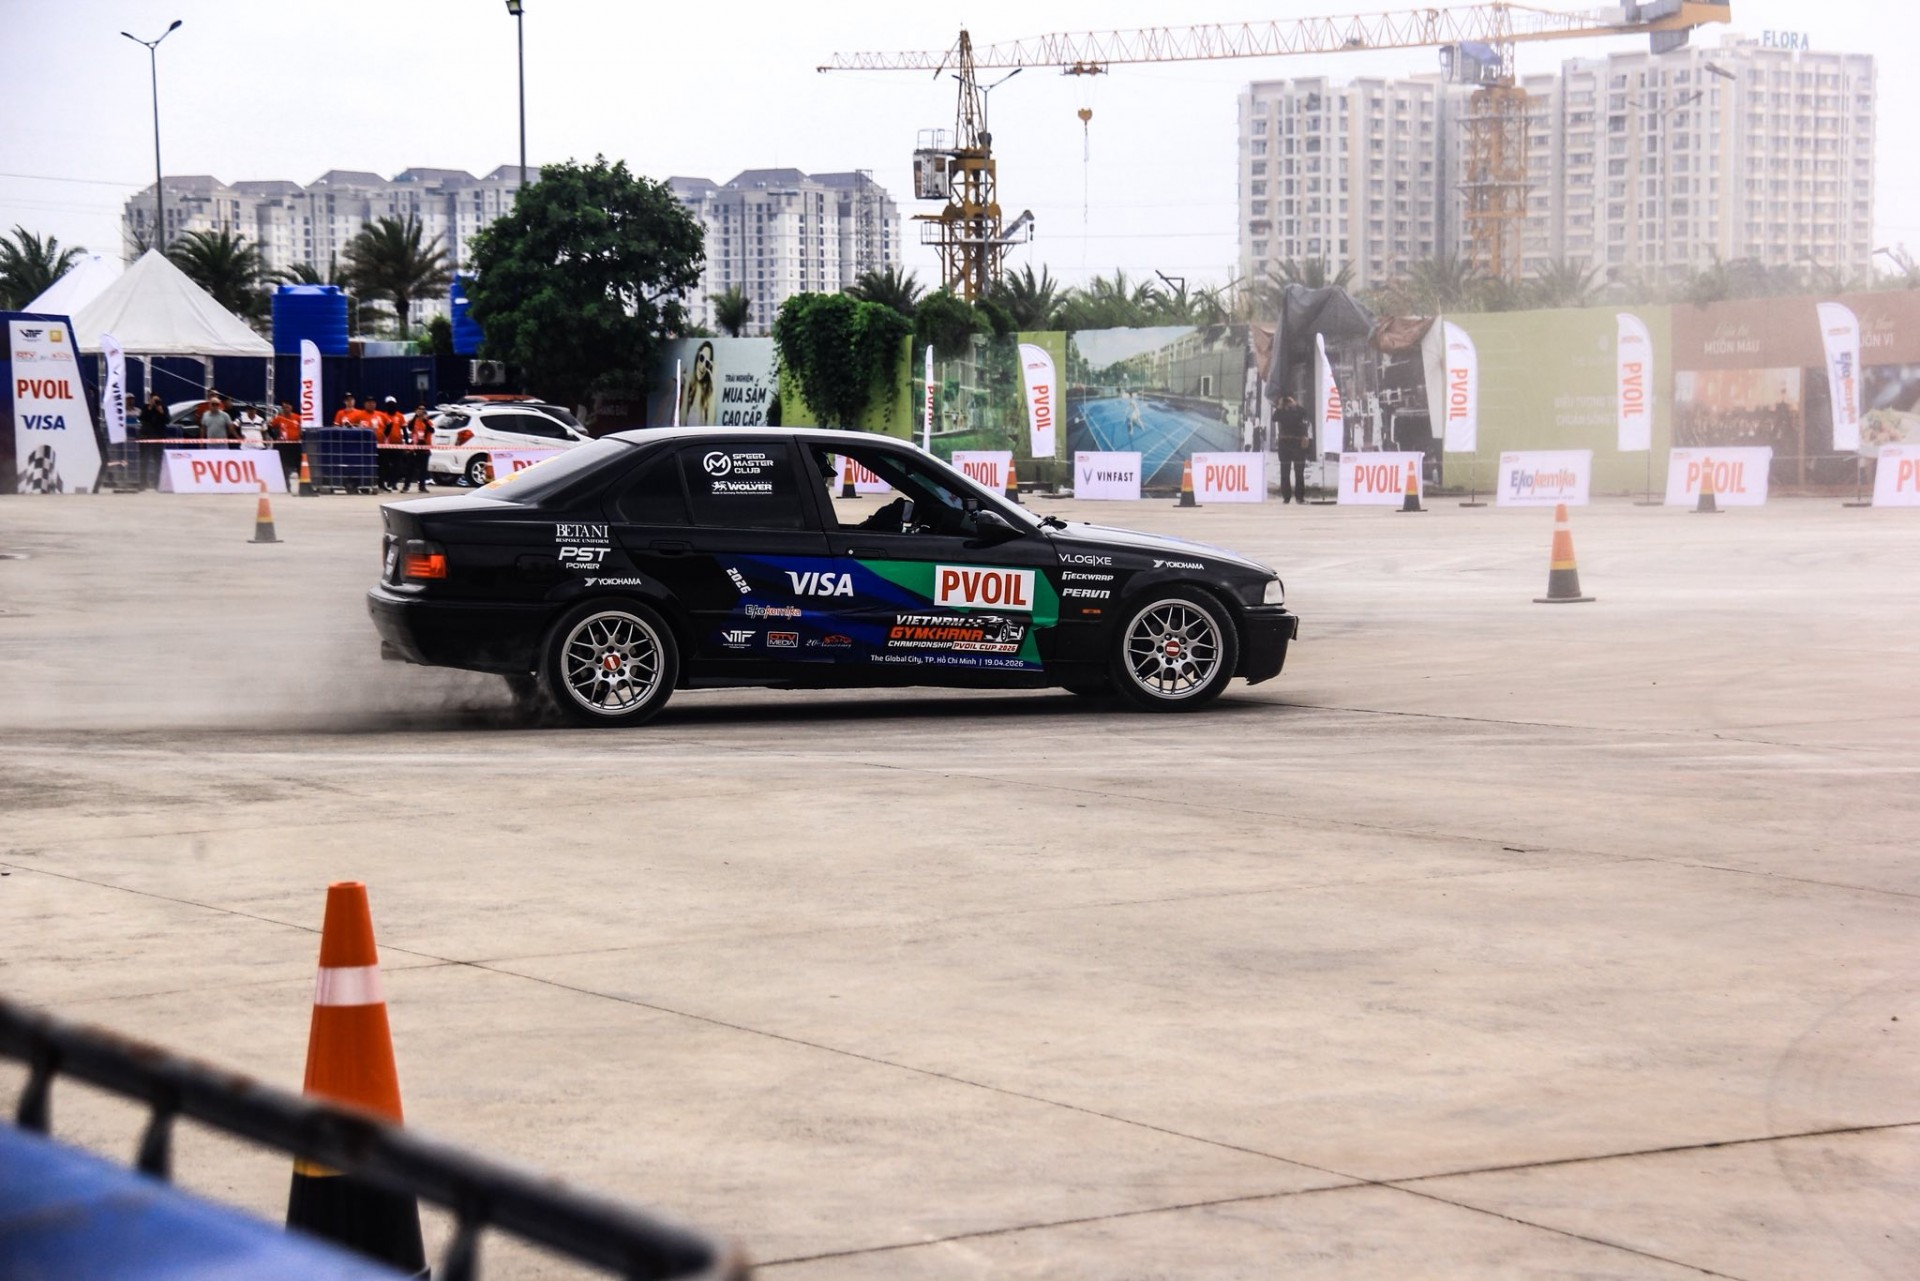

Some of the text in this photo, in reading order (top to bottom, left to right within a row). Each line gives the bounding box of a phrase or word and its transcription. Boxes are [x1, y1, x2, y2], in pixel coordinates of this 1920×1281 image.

[1763, 30, 1809, 51] FLORA
[17, 380, 73, 399] PVOIL
[722, 388, 743, 403] MUA
[1449, 368, 1468, 421] PVOIL
[1623, 363, 1643, 418] PVOIL
[1032, 385, 1051, 431] PVOIL
[21, 415, 66, 430] VISA
[722, 411, 741, 426] CAO
[192, 461, 261, 483] PVOIL
[1097, 471, 1134, 482] VINFAST
[1205, 465, 1249, 492] PVOIL
[1354, 465, 1401, 493] PVOIL
[726, 482, 773, 491] WOLVER
[556, 524, 608, 538] BETANI
[558, 546, 611, 562] PST
[1165, 560, 1205, 570] YOKOHAMA
[597, 577, 641, 585] YOKOHAMA
[726, 567, 752, 594] 2026
[784, 571, 854, 597] VISA
[941, 570, 1027, 606] PVOIL
[896, 615, 965, 627] VIETNAM
[890, 626, 984, 641] GYMKHANA
[888, 640, 953, 649] CHAMPIONSHIP
[953, 642, 977, 650] PVOIL
[925, 656, 936, 664] TP.
[984, 659, 1024, 668] 19.04.2026
